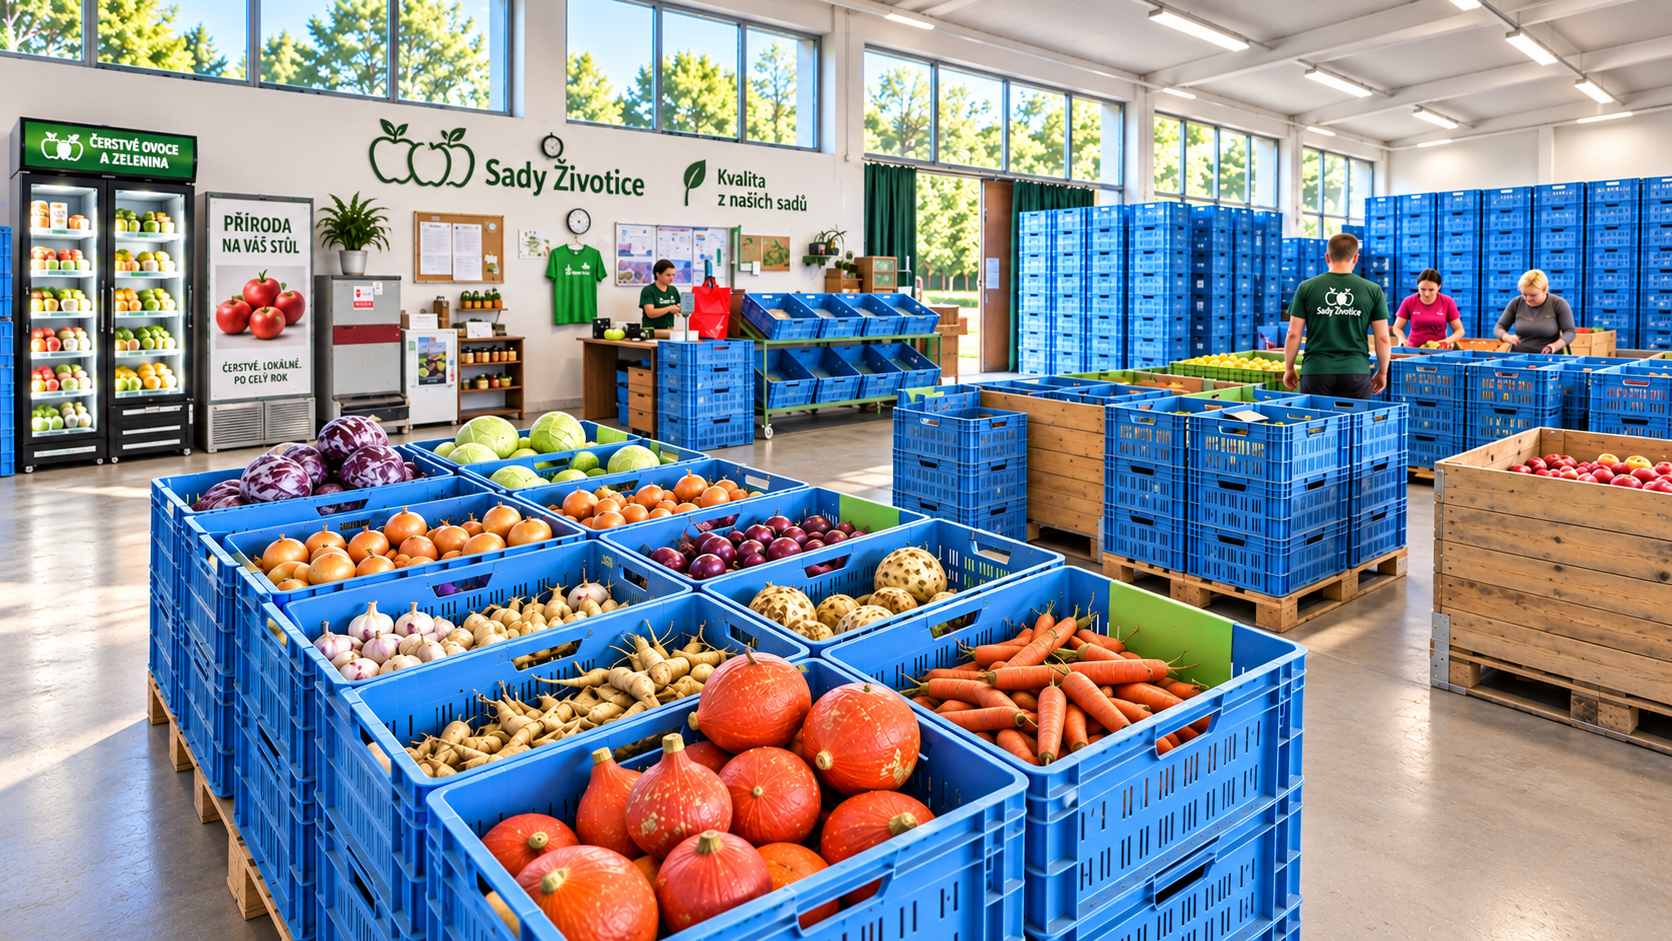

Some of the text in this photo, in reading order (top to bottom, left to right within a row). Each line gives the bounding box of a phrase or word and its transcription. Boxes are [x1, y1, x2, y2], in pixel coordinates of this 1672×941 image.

[89, 132, 179, 156] ČERSTVÉ OVOCE
[99, 152, 170, 169] A ZELENINA
[485, 158, 646, 197] Sady Životice
[717, 168, 767, 189] Kvalita
[717, 191, 808, 212] z našich sadů
[223, 211, 292, 234] PŘÍRODA
[222, 237, 242, 254] NA
[243, 235, 267, 254] VÁŠ
[1316, 306, 1334, 317] Sady
[234, 375, 247, 386] PO
[270, 372, 289, 383] ROK
